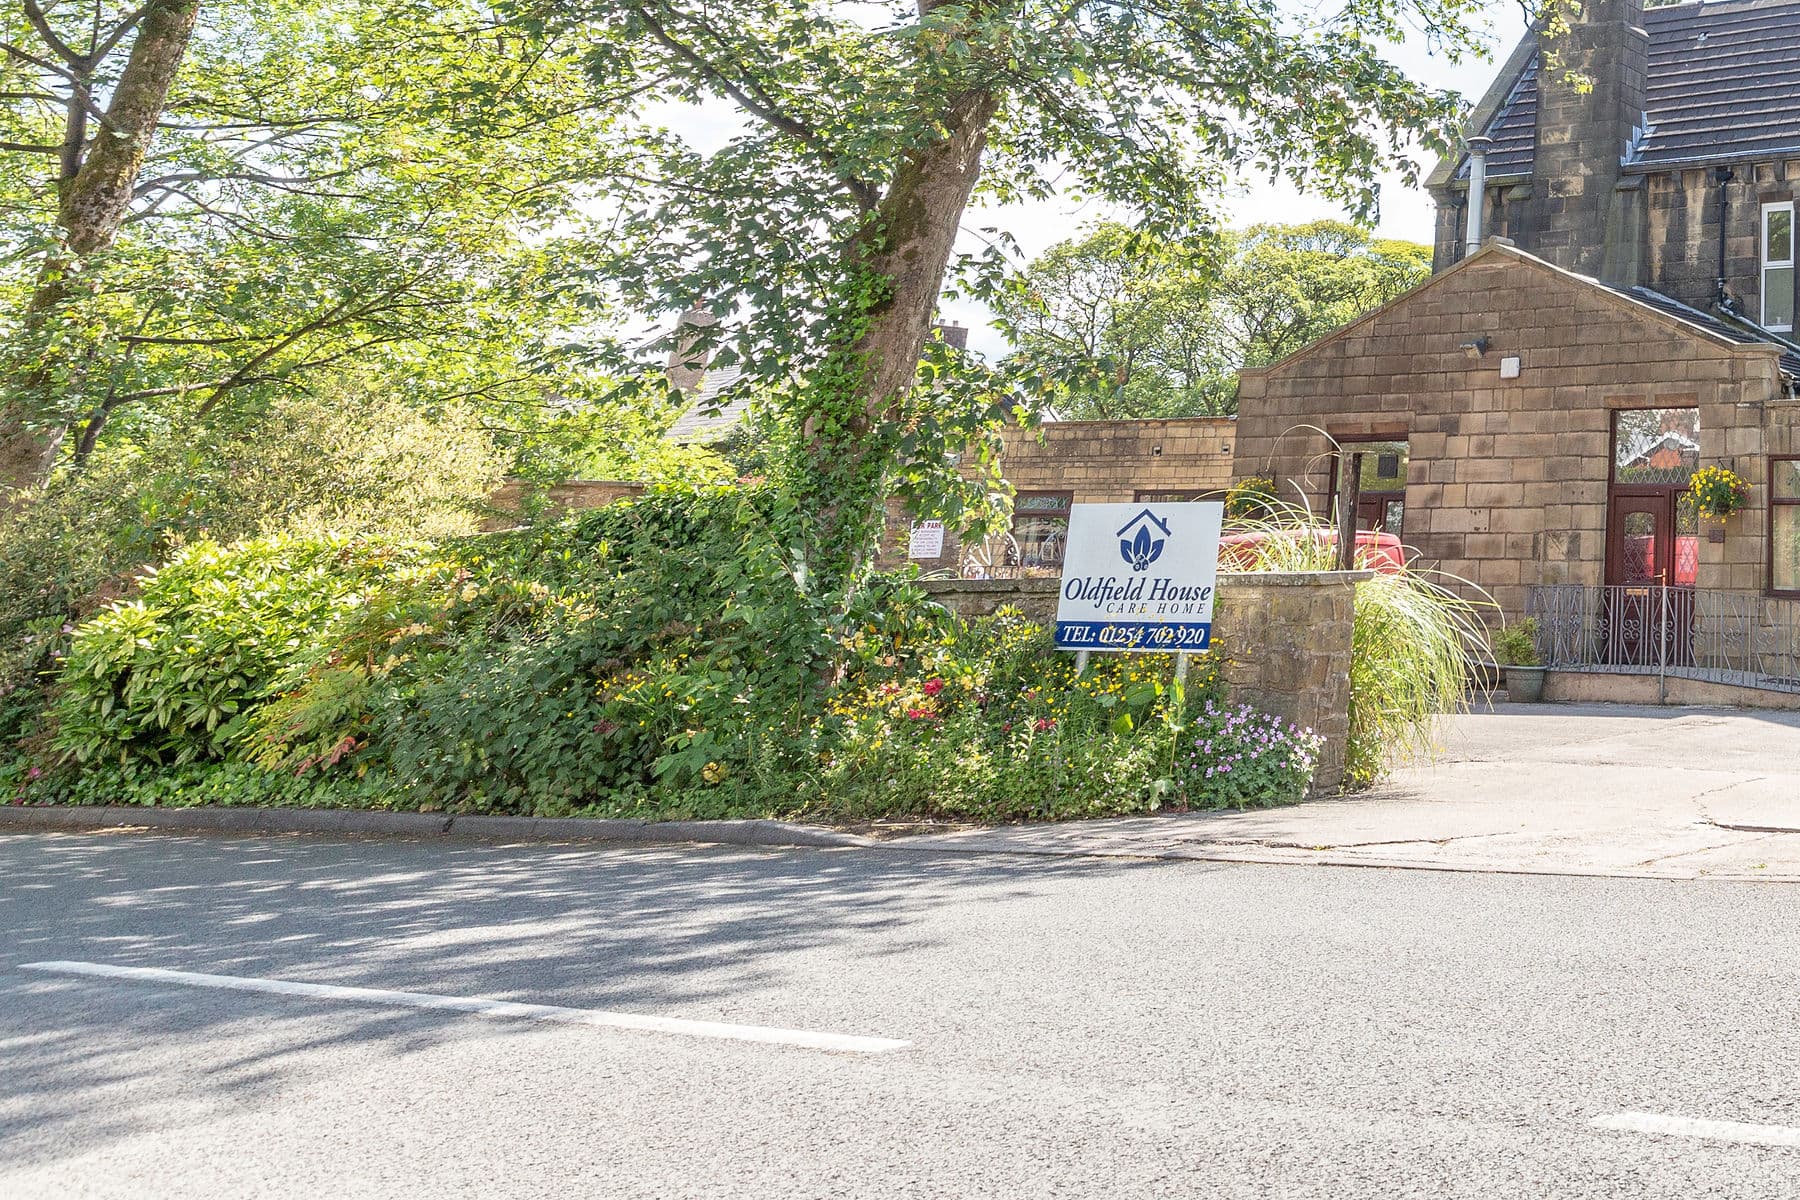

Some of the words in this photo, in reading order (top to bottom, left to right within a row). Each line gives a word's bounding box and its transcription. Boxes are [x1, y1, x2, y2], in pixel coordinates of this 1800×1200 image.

[1065, 576, 1148, 609] Oldfield
[1148, 578, 1211, 601] House
[1106, 602, 1148, 614] CARE
[1157, 602, 1206, 614] HOME
[1062, 625, 1096, 643] TEL:
[1099, 625, 1145, 644] 01254
[1145, 627, 1174, 645] 702
[1174, 627, 1205, 646] 920
